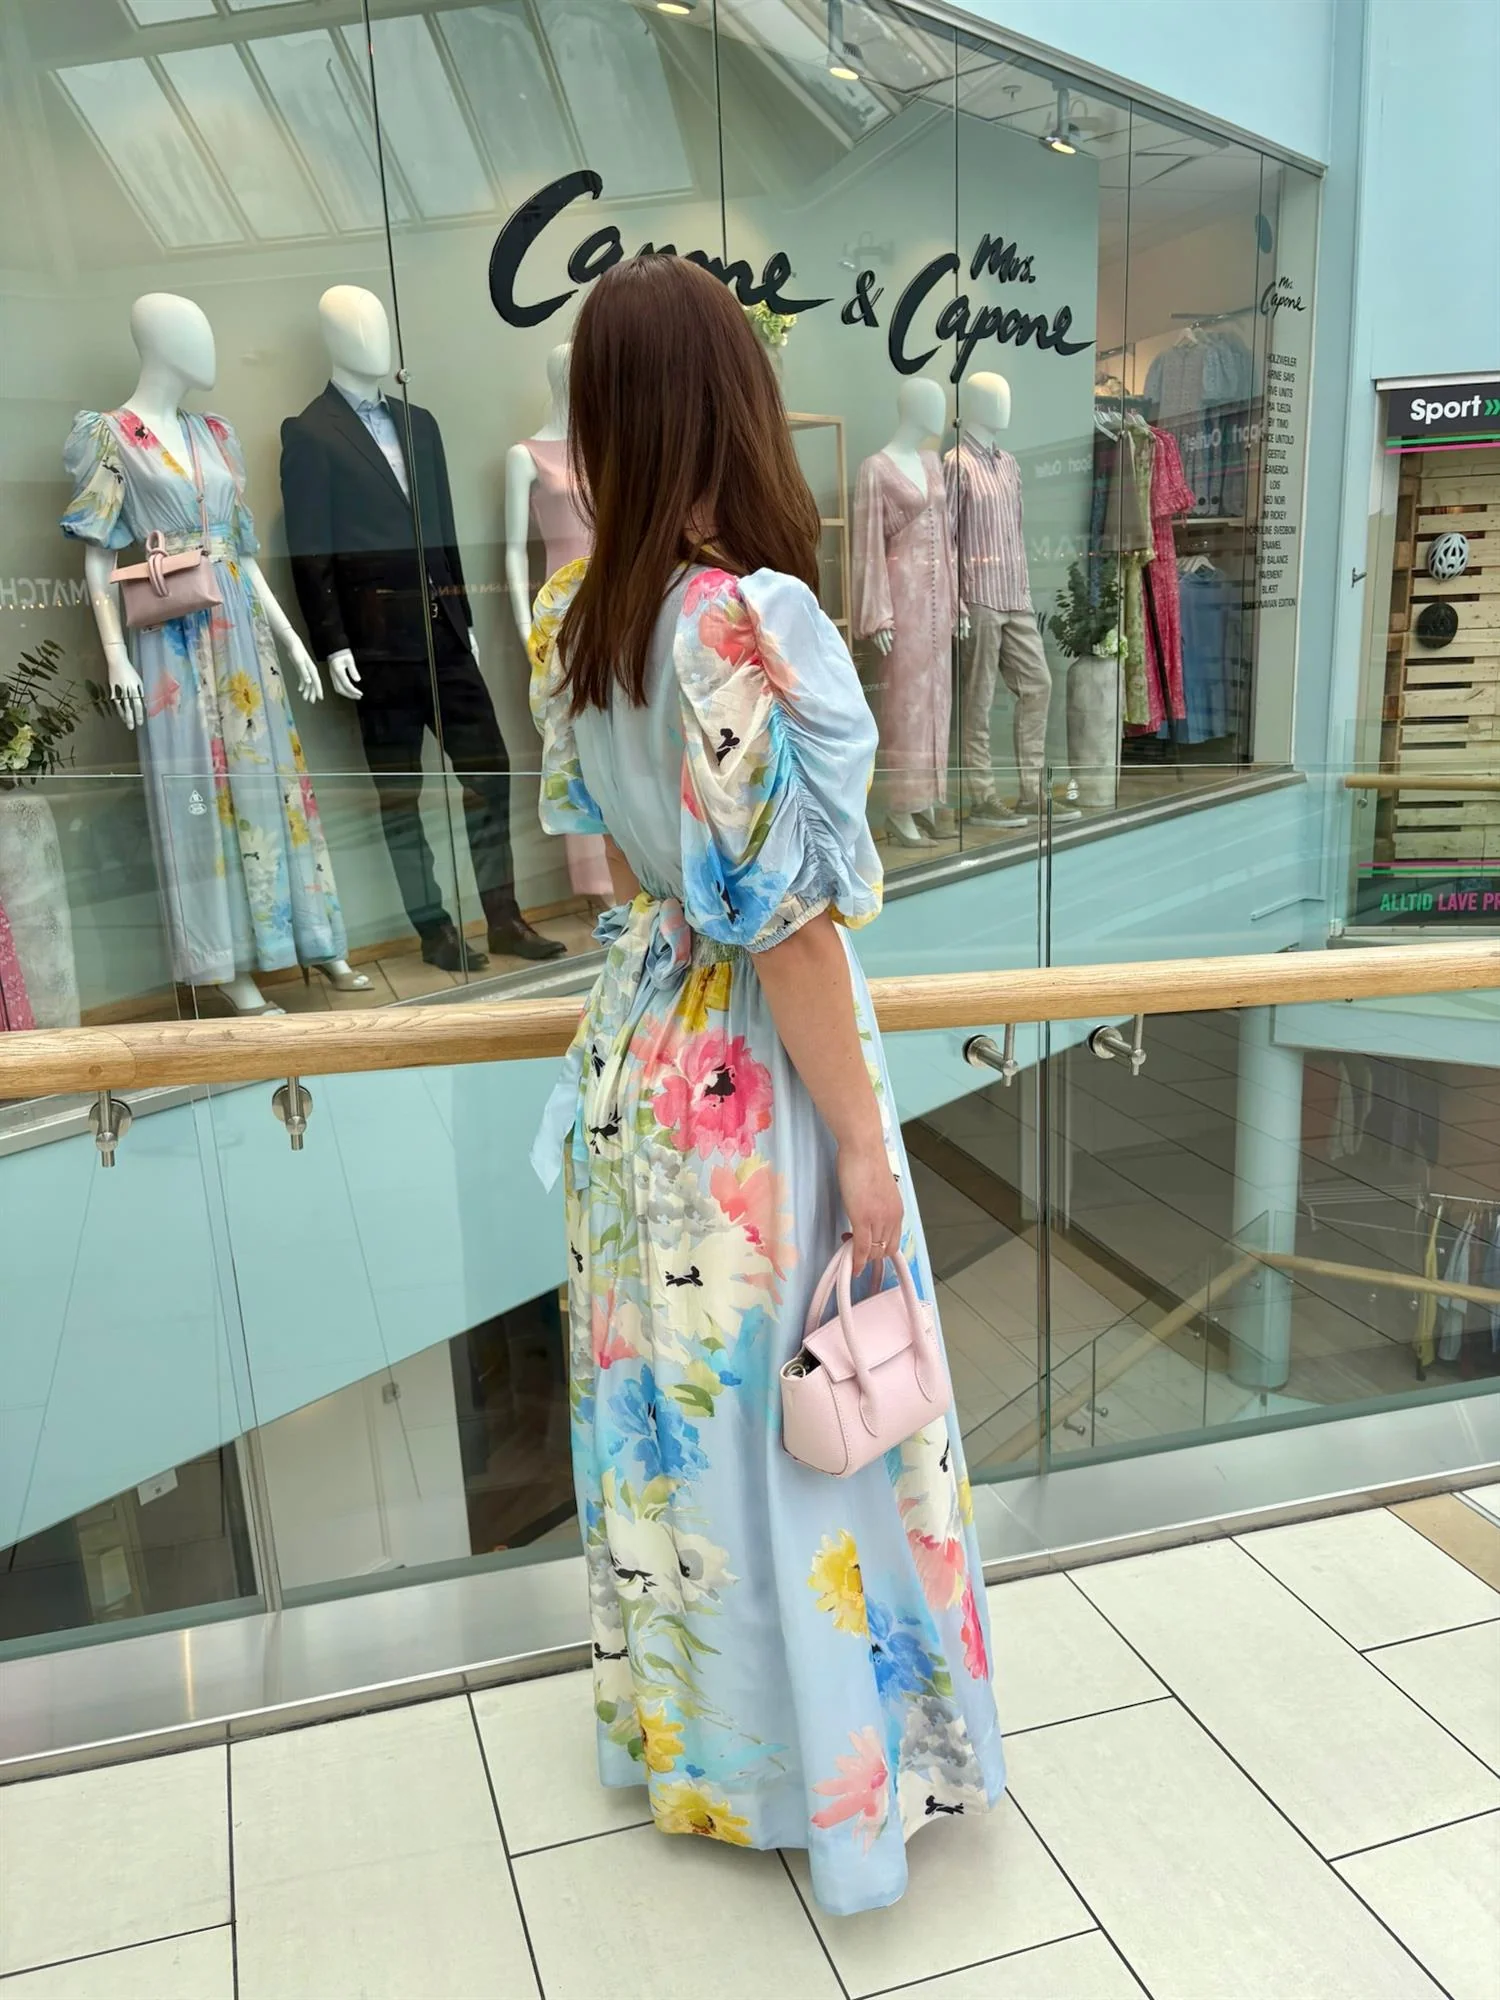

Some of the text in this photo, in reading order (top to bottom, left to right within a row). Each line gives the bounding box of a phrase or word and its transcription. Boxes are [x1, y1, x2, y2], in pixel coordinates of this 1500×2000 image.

[489, 169, 885, 328] Cane &
[1260, 281, 1306, 320] Capone
[888, 252, 1097, 383] Capone
[1410, 395, 1481, 425] Sport
[1266, 555, 1289, 565] BALANCE
[1278, 598, 1297, 608] EDITION
[1380, 893, 1433, 911] ALLTID
[1438, 892, 1478, 911] LAVE
